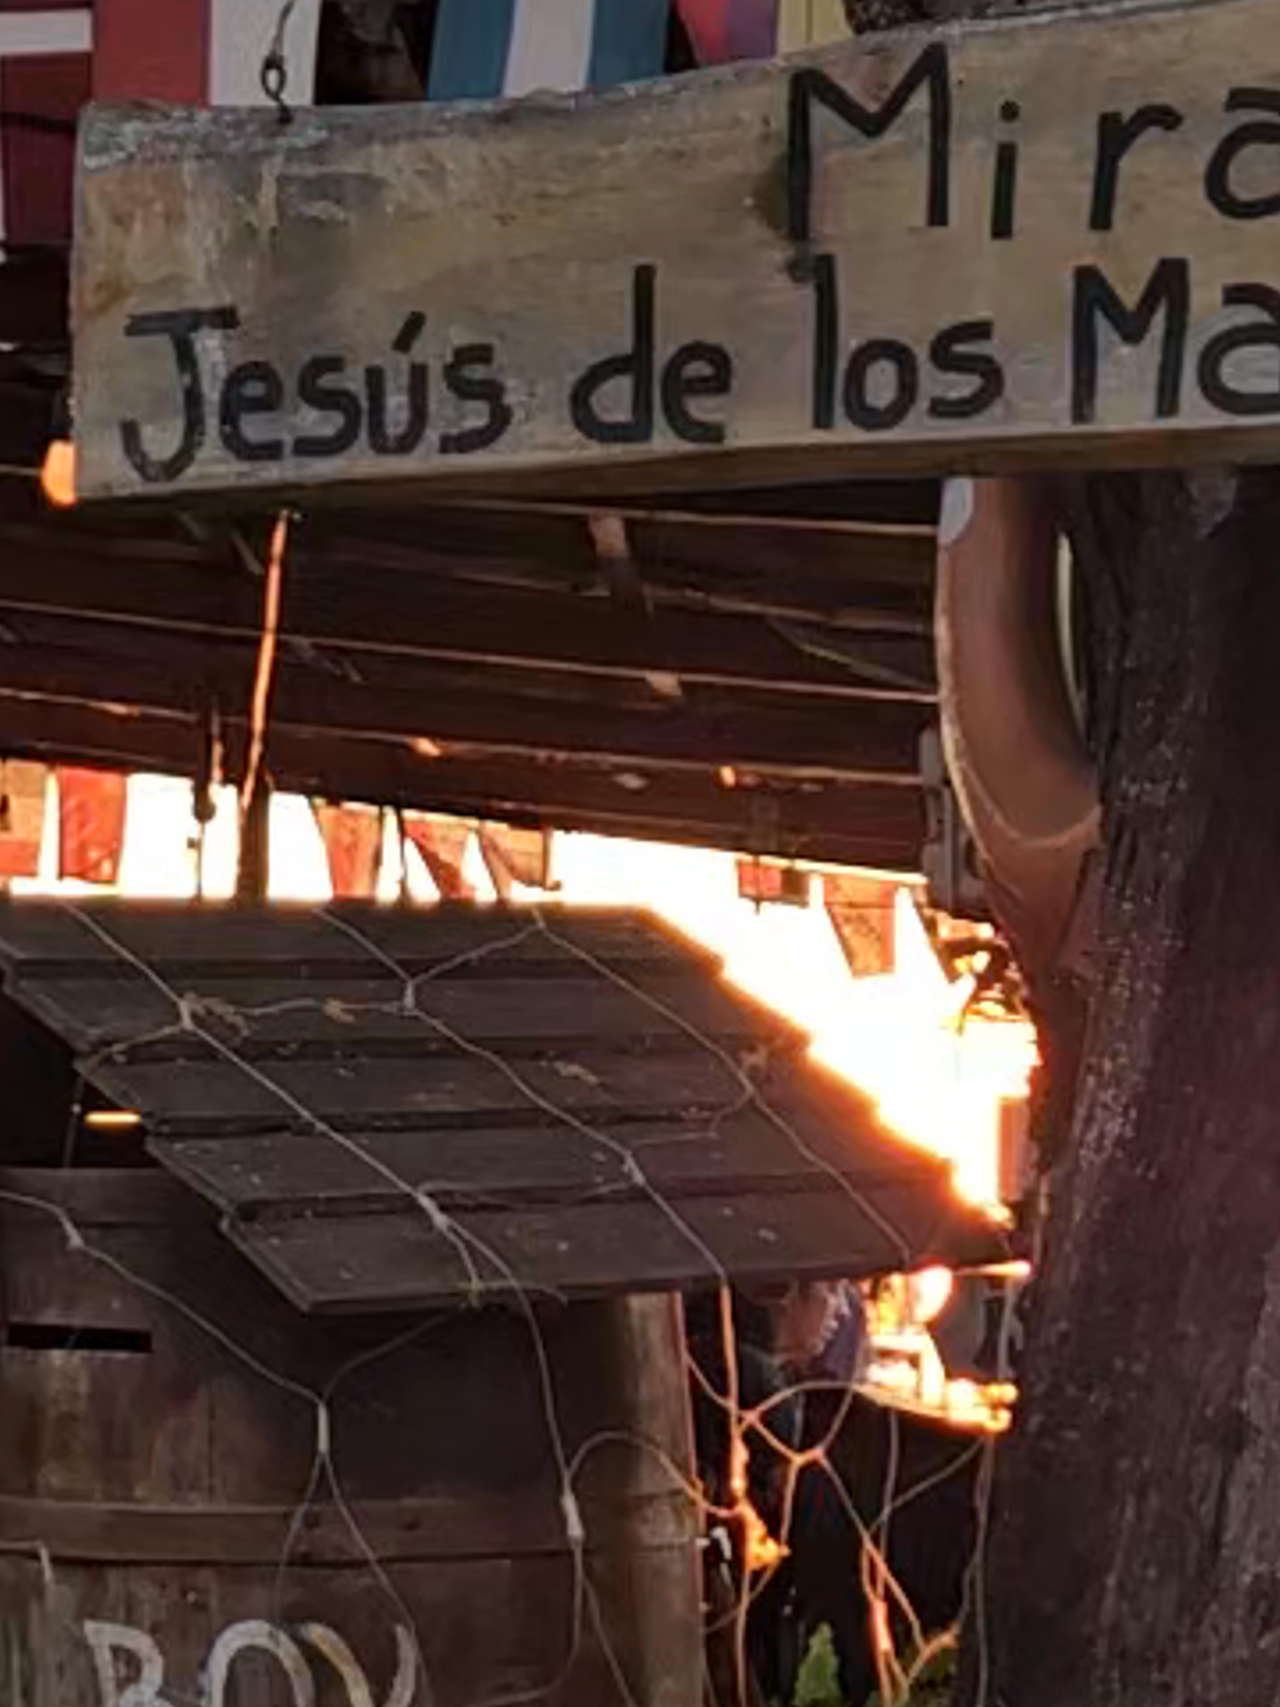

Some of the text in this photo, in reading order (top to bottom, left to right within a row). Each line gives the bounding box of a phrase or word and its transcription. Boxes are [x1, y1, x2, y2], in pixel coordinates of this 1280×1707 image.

[121, 306, 513, 483] Jesús
[569, 263, 733, 445] de
[812, 254, 1005, 431] los
